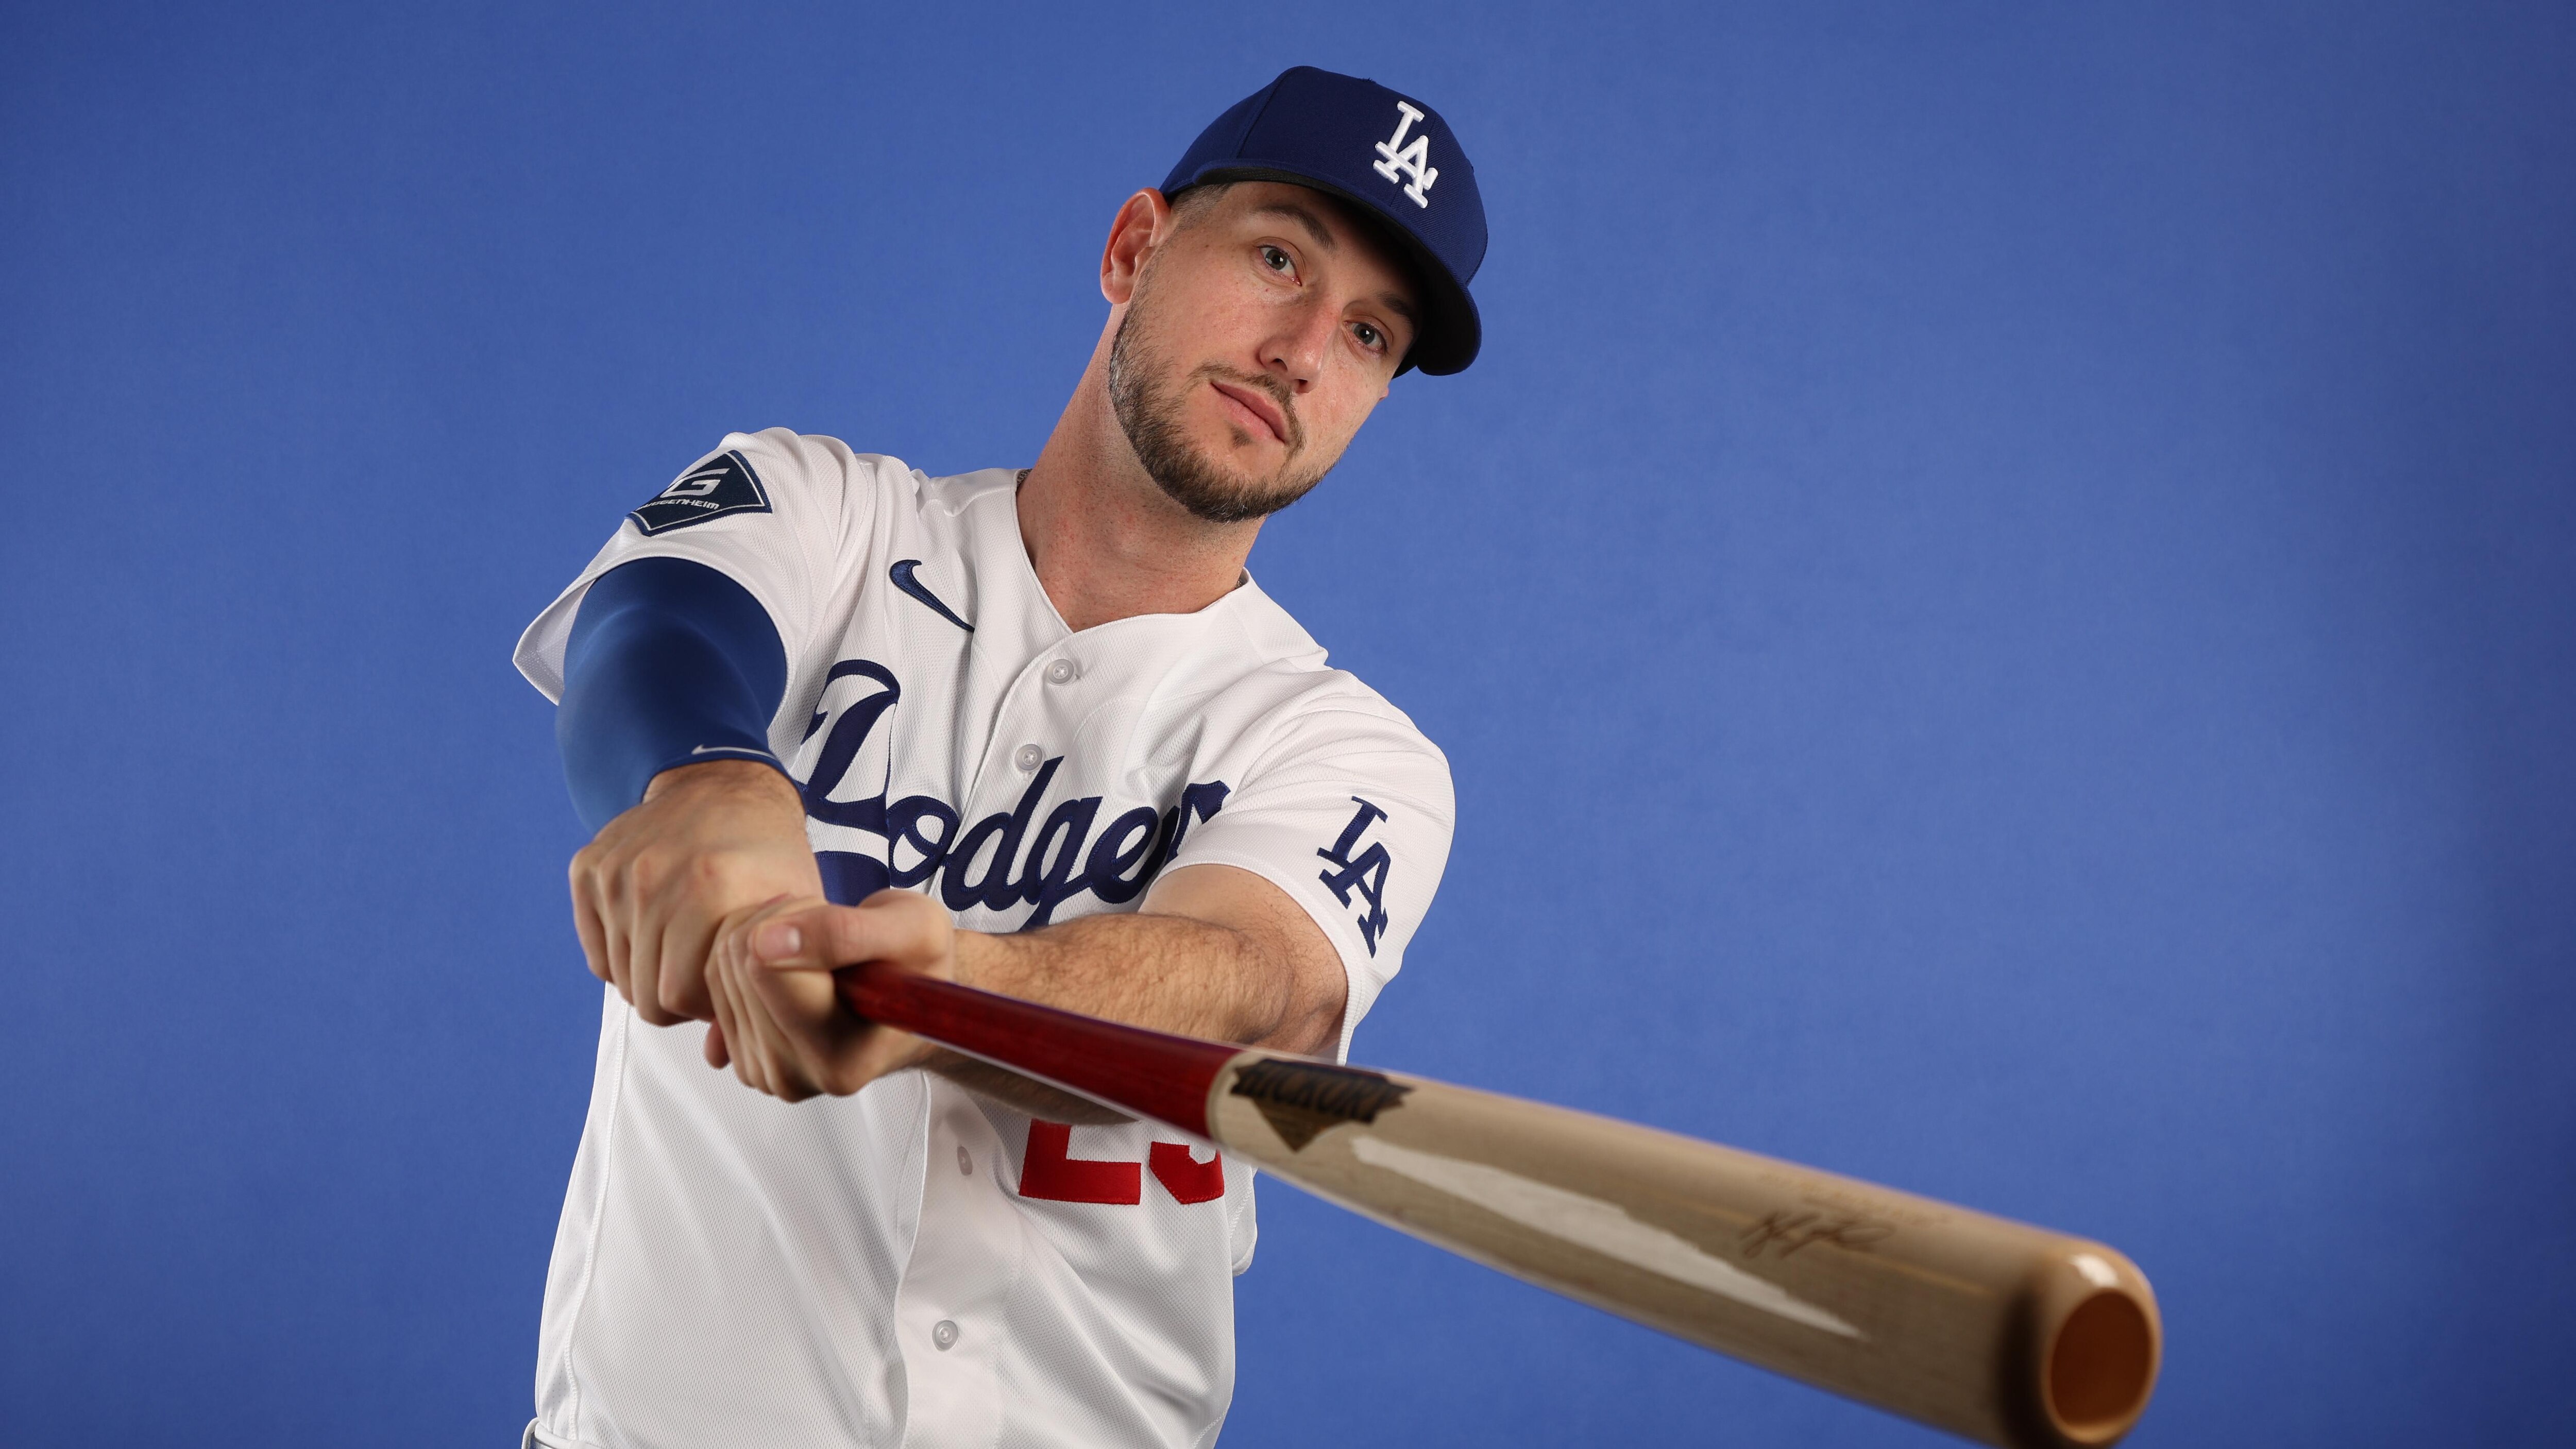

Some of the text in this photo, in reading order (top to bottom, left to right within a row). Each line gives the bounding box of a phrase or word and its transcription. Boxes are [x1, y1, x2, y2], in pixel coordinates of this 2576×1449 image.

[1373, 100, 1438, 209] LA
[635, 499, 720, 512] UGGENHEIM
[1317, 795, 1391, 959] LA
